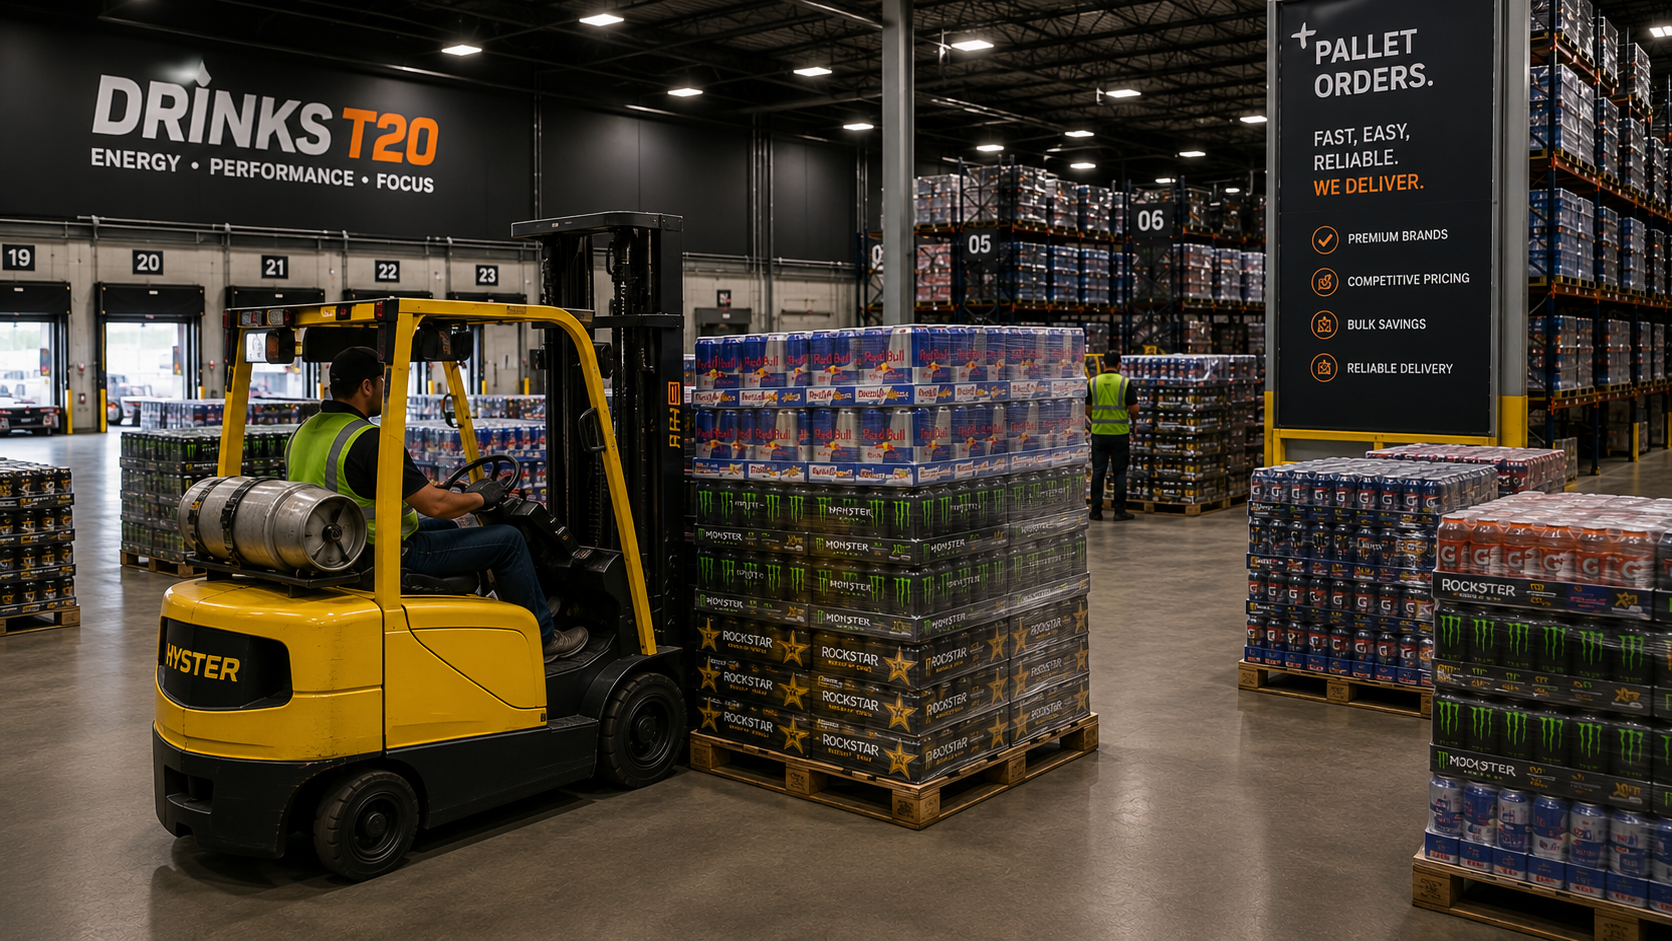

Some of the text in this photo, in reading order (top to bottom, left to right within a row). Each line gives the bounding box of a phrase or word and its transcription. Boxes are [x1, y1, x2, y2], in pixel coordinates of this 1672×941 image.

[1316, 28, 1418, 65] PALLET
[1314, 62, 1434, 98] ORDERS.
[92, 63, 439, 166] DRINKS T20
[1314, 123, 1410, 147] FAST, EASY,
[1314, 149, 1398, 170] RELIABLE.
[91, 148, 434, 194] ENERGY PERFORMANCE FOCUS
[1314, 173, 1424, 196] WE DELIVER.
[1138, 209, 1164, 232] 06
[968, 234, 991, 254] 05
[1348, 229, 1448, 244] PREMIUM BRANDS
[8, 248, 30, 266] 19
[136, 253, 160, 272] 20
[266, 258, 285, 276] 21
[378, 262, 398, 279] 22
[478, 267, 496, 284] 23
[1348, 272, 1470, 287] COMPETITIVE PRICING
[1348, 318, 1426, 330] BULK SAVINGS
[1347, 363, 1454, 374] RELIABLE DELIVERY
[886, 428, 905, 441] Bull
[1336, 492, 1345, 502] G
[1360, 493, 1369, 503] G
[826, 540, 869, 552] MONSTER
[1441, 545, 1455, 563] G
[1474, 548, 1490, 566] G
[1508, 551, 1523, 568] G
[1583, 557, 1599, 575] G
[1268, 586, 1276, 596] G
[1289, 589, 1297, 599] G
[1442, 578, 1516, 597] ROCKSTER
[1333, 596, 1342, 605] G
[1358, 597, 1367, 608] G
[1381, 600, 1391, 610] G
[826, 613, 870, 626] MONSTER
[723, 630, 773, 648] ROCKSTAR
[1356, 643, 1366, 653] G
[166, 642, 240, 682] HYSTER
[822, 646, 878, 666] ROCKSTAR
[724, 671, 772, 690] ROCKSTAR
[822, 690, 879, 711] ROCKSTAR
[724, 711, 773, 733] ROCKSTAR
[823, 733, 879, 756] ROCKSTAR
